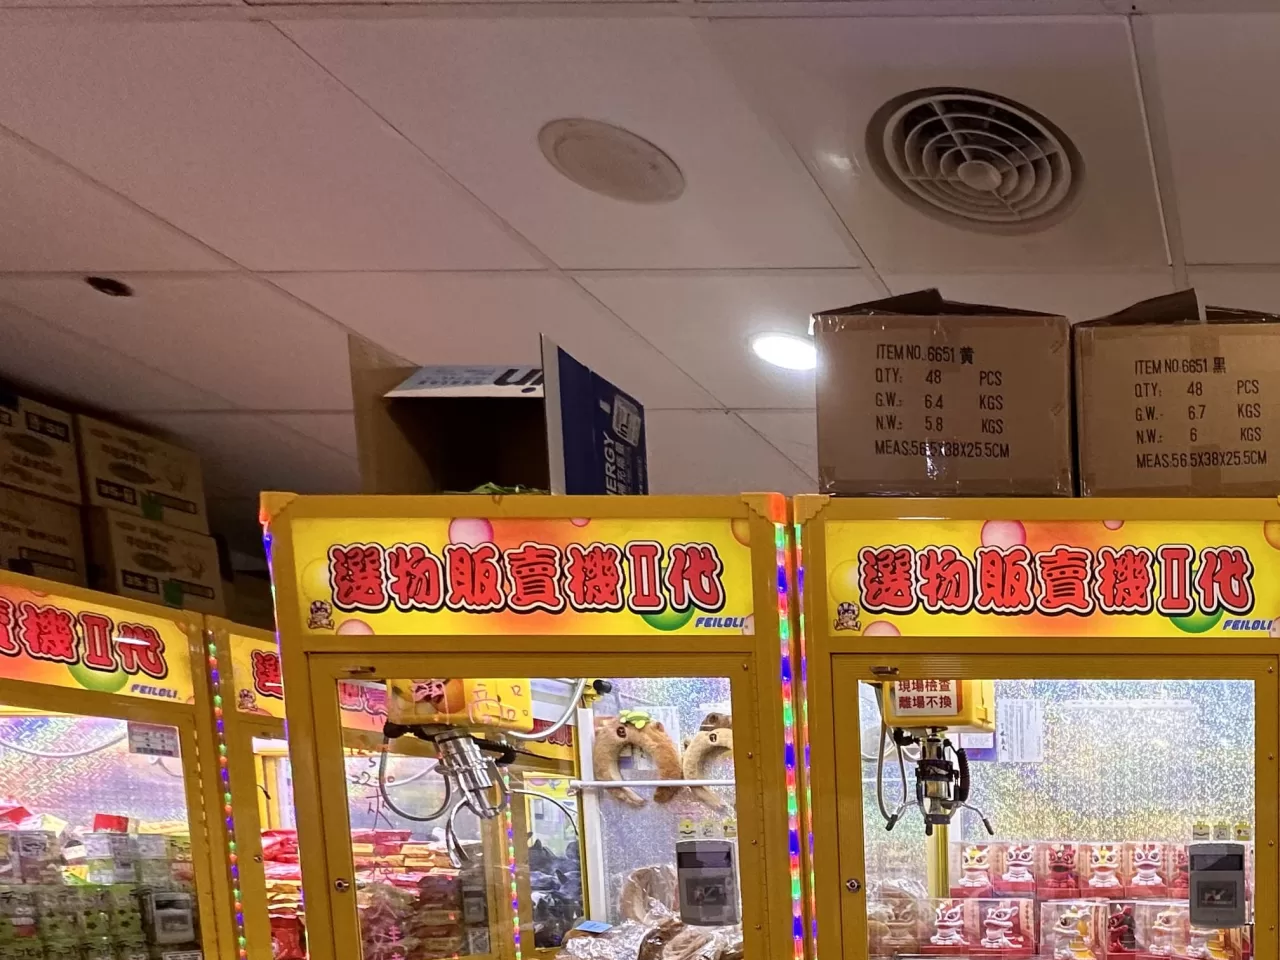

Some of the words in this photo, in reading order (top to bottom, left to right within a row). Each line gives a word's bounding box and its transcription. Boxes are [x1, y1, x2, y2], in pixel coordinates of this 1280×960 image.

[876, 344, 904, 360] ITEM
[1135, 359, 1161, 374] ITEM
[1213, 357, 1226, 373] 黑
[925, 370, 941, 384] 48
[980, 371, 1002, 386] PCS
[1135, 382, 1162, 397] QTY:
[1187, 382, 1203, 396] 48
[1237, 380, 1259, 395] PCS
[925, 395, 944, 409] 6.4
[980, 395, 1003, 410] KGS
[1188, 405, 1206, 420] 6.7
[1238, 403, 1261, 418] KGS
[925, 416, 943, 431] 5.8
[982, 419, 1003, 434] KGS
[1190, 428, 1197, 442] 6
[1240, 427, 1261, 441] KGS
[694, 616, 745, 628] FEILOLI
[1222, 619, 1273, 631] FEILOLI
[898, 696, 952, 709] 離場不換
